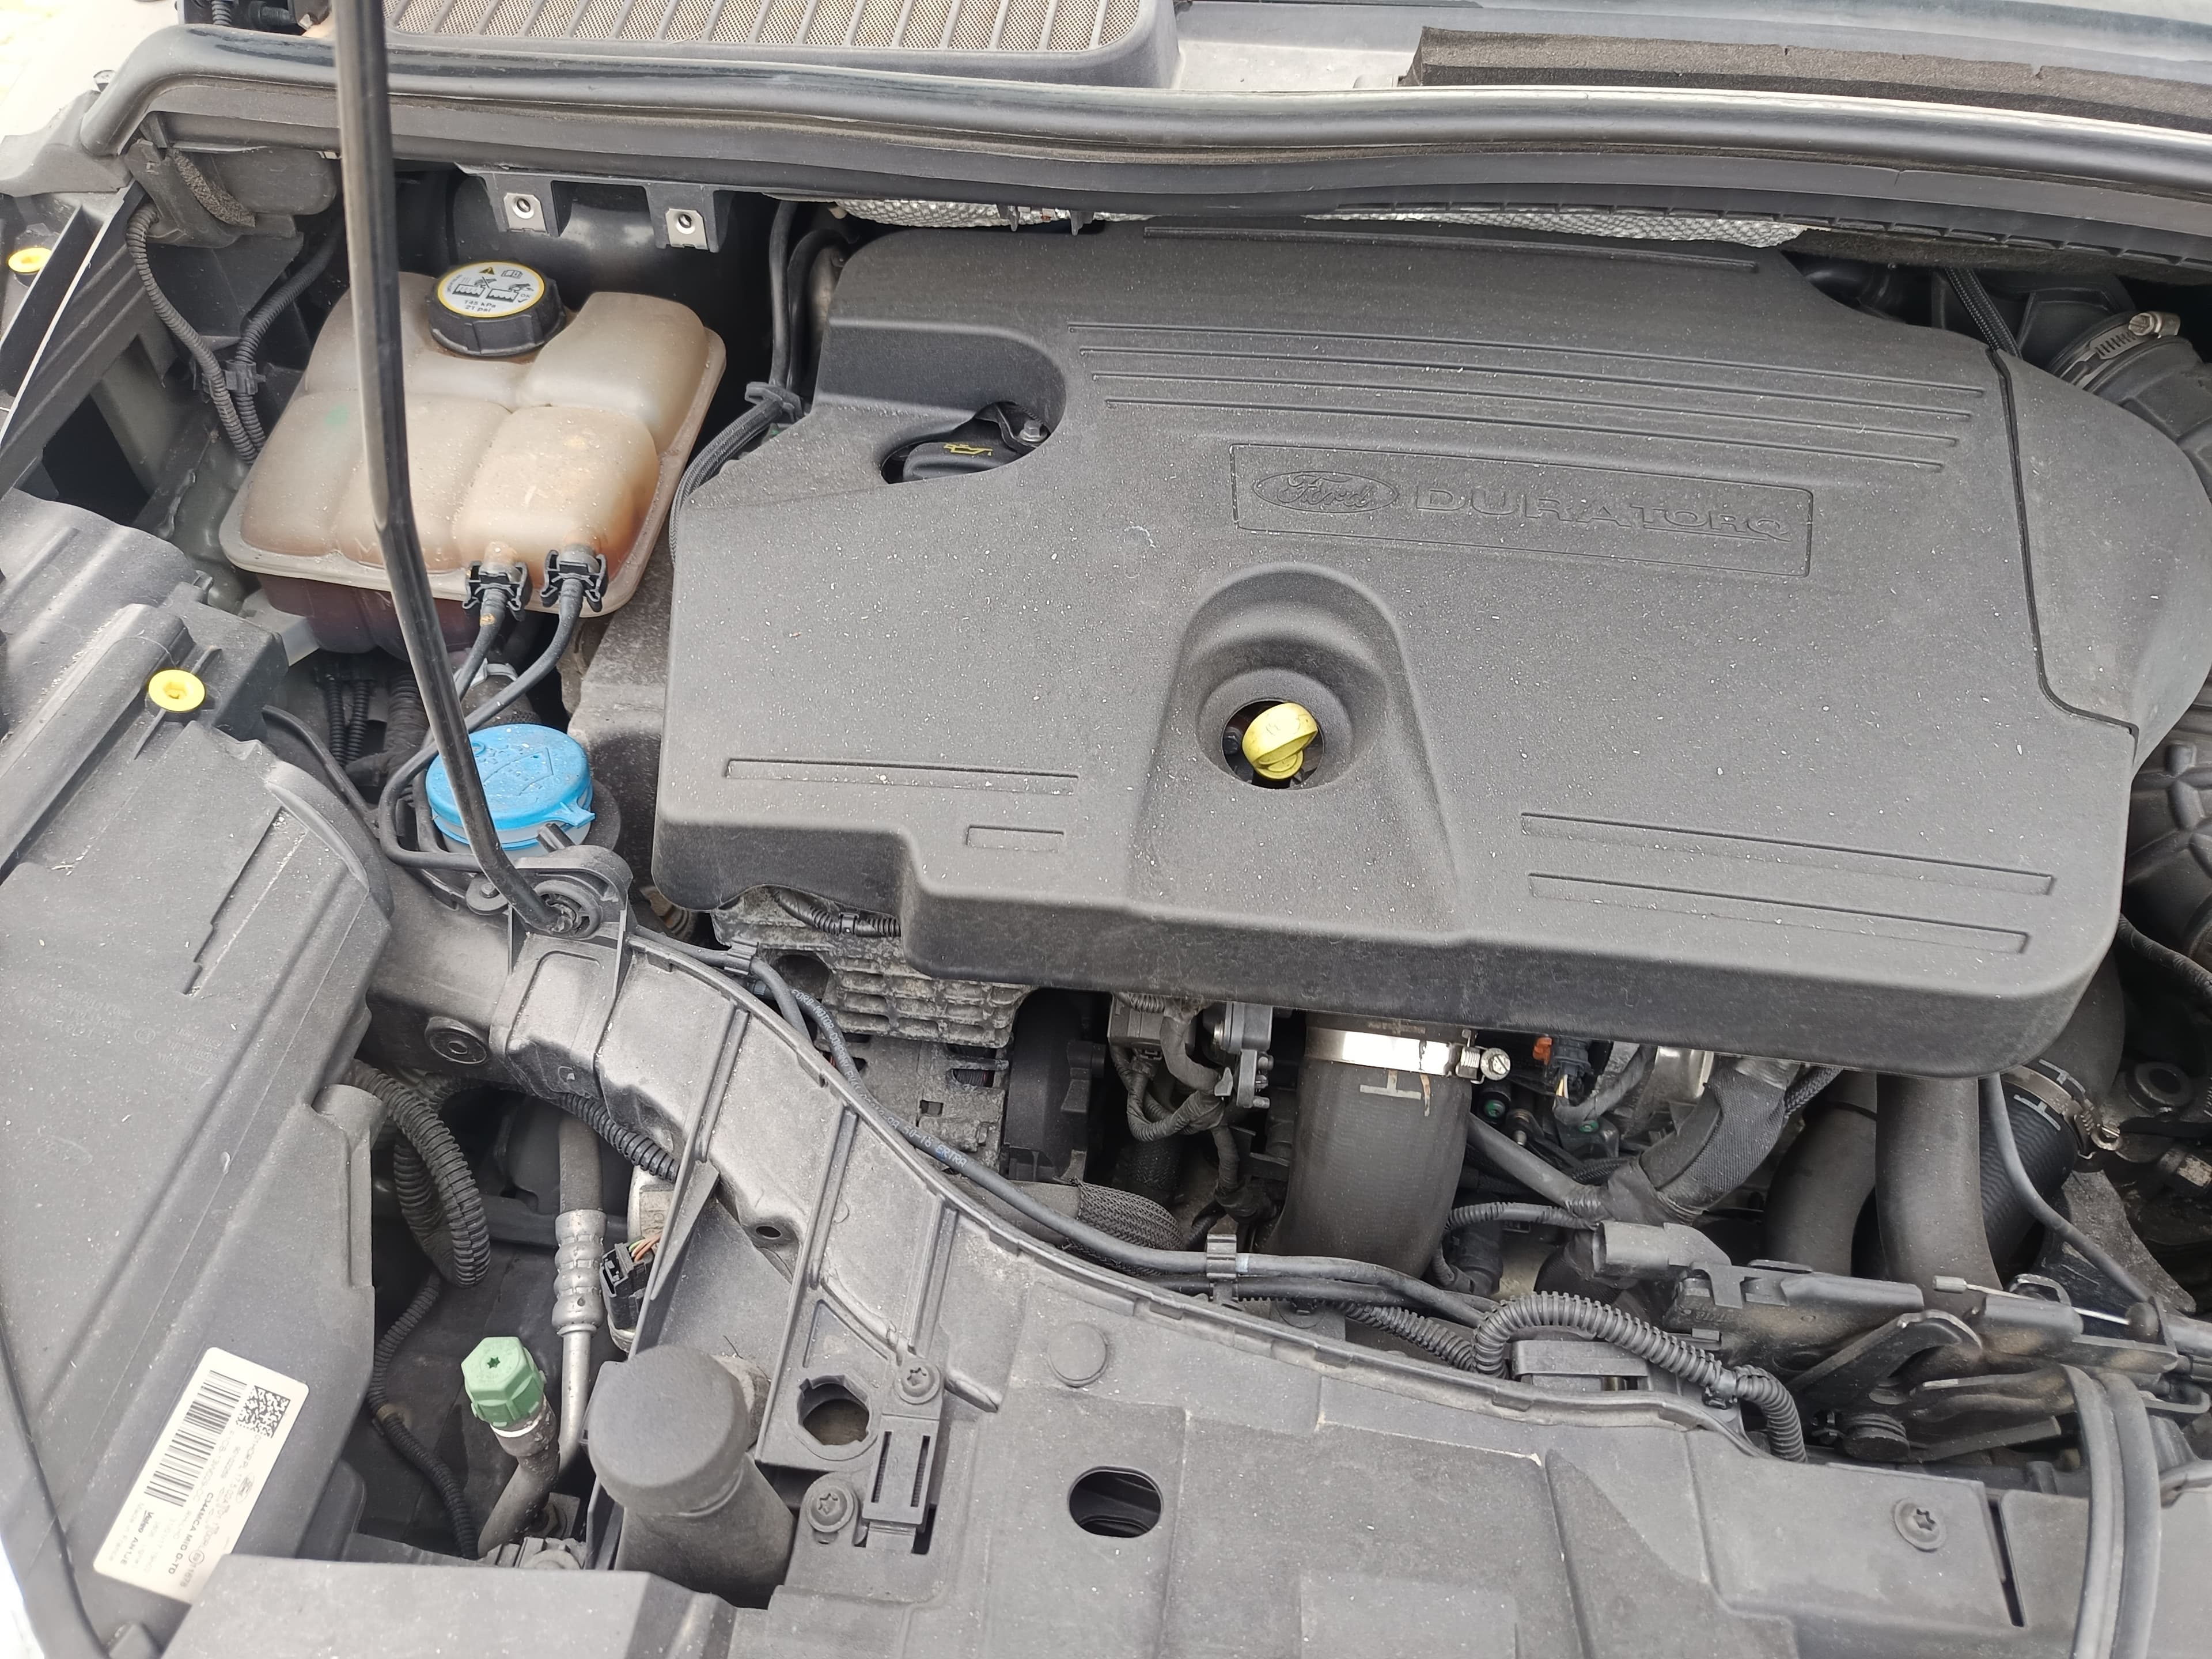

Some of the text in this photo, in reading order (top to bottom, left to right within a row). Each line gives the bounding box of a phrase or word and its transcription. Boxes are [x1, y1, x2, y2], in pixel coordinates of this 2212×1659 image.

[1277, 474, 1791, 543] Ford DURATORQ
[791, 988, 815, 1006] FORD
[813, 1006, 835, 1030] MOTOR
[136, 1509, 154, 1534] Valeo
[179, 1533, 192, 1551] MID
